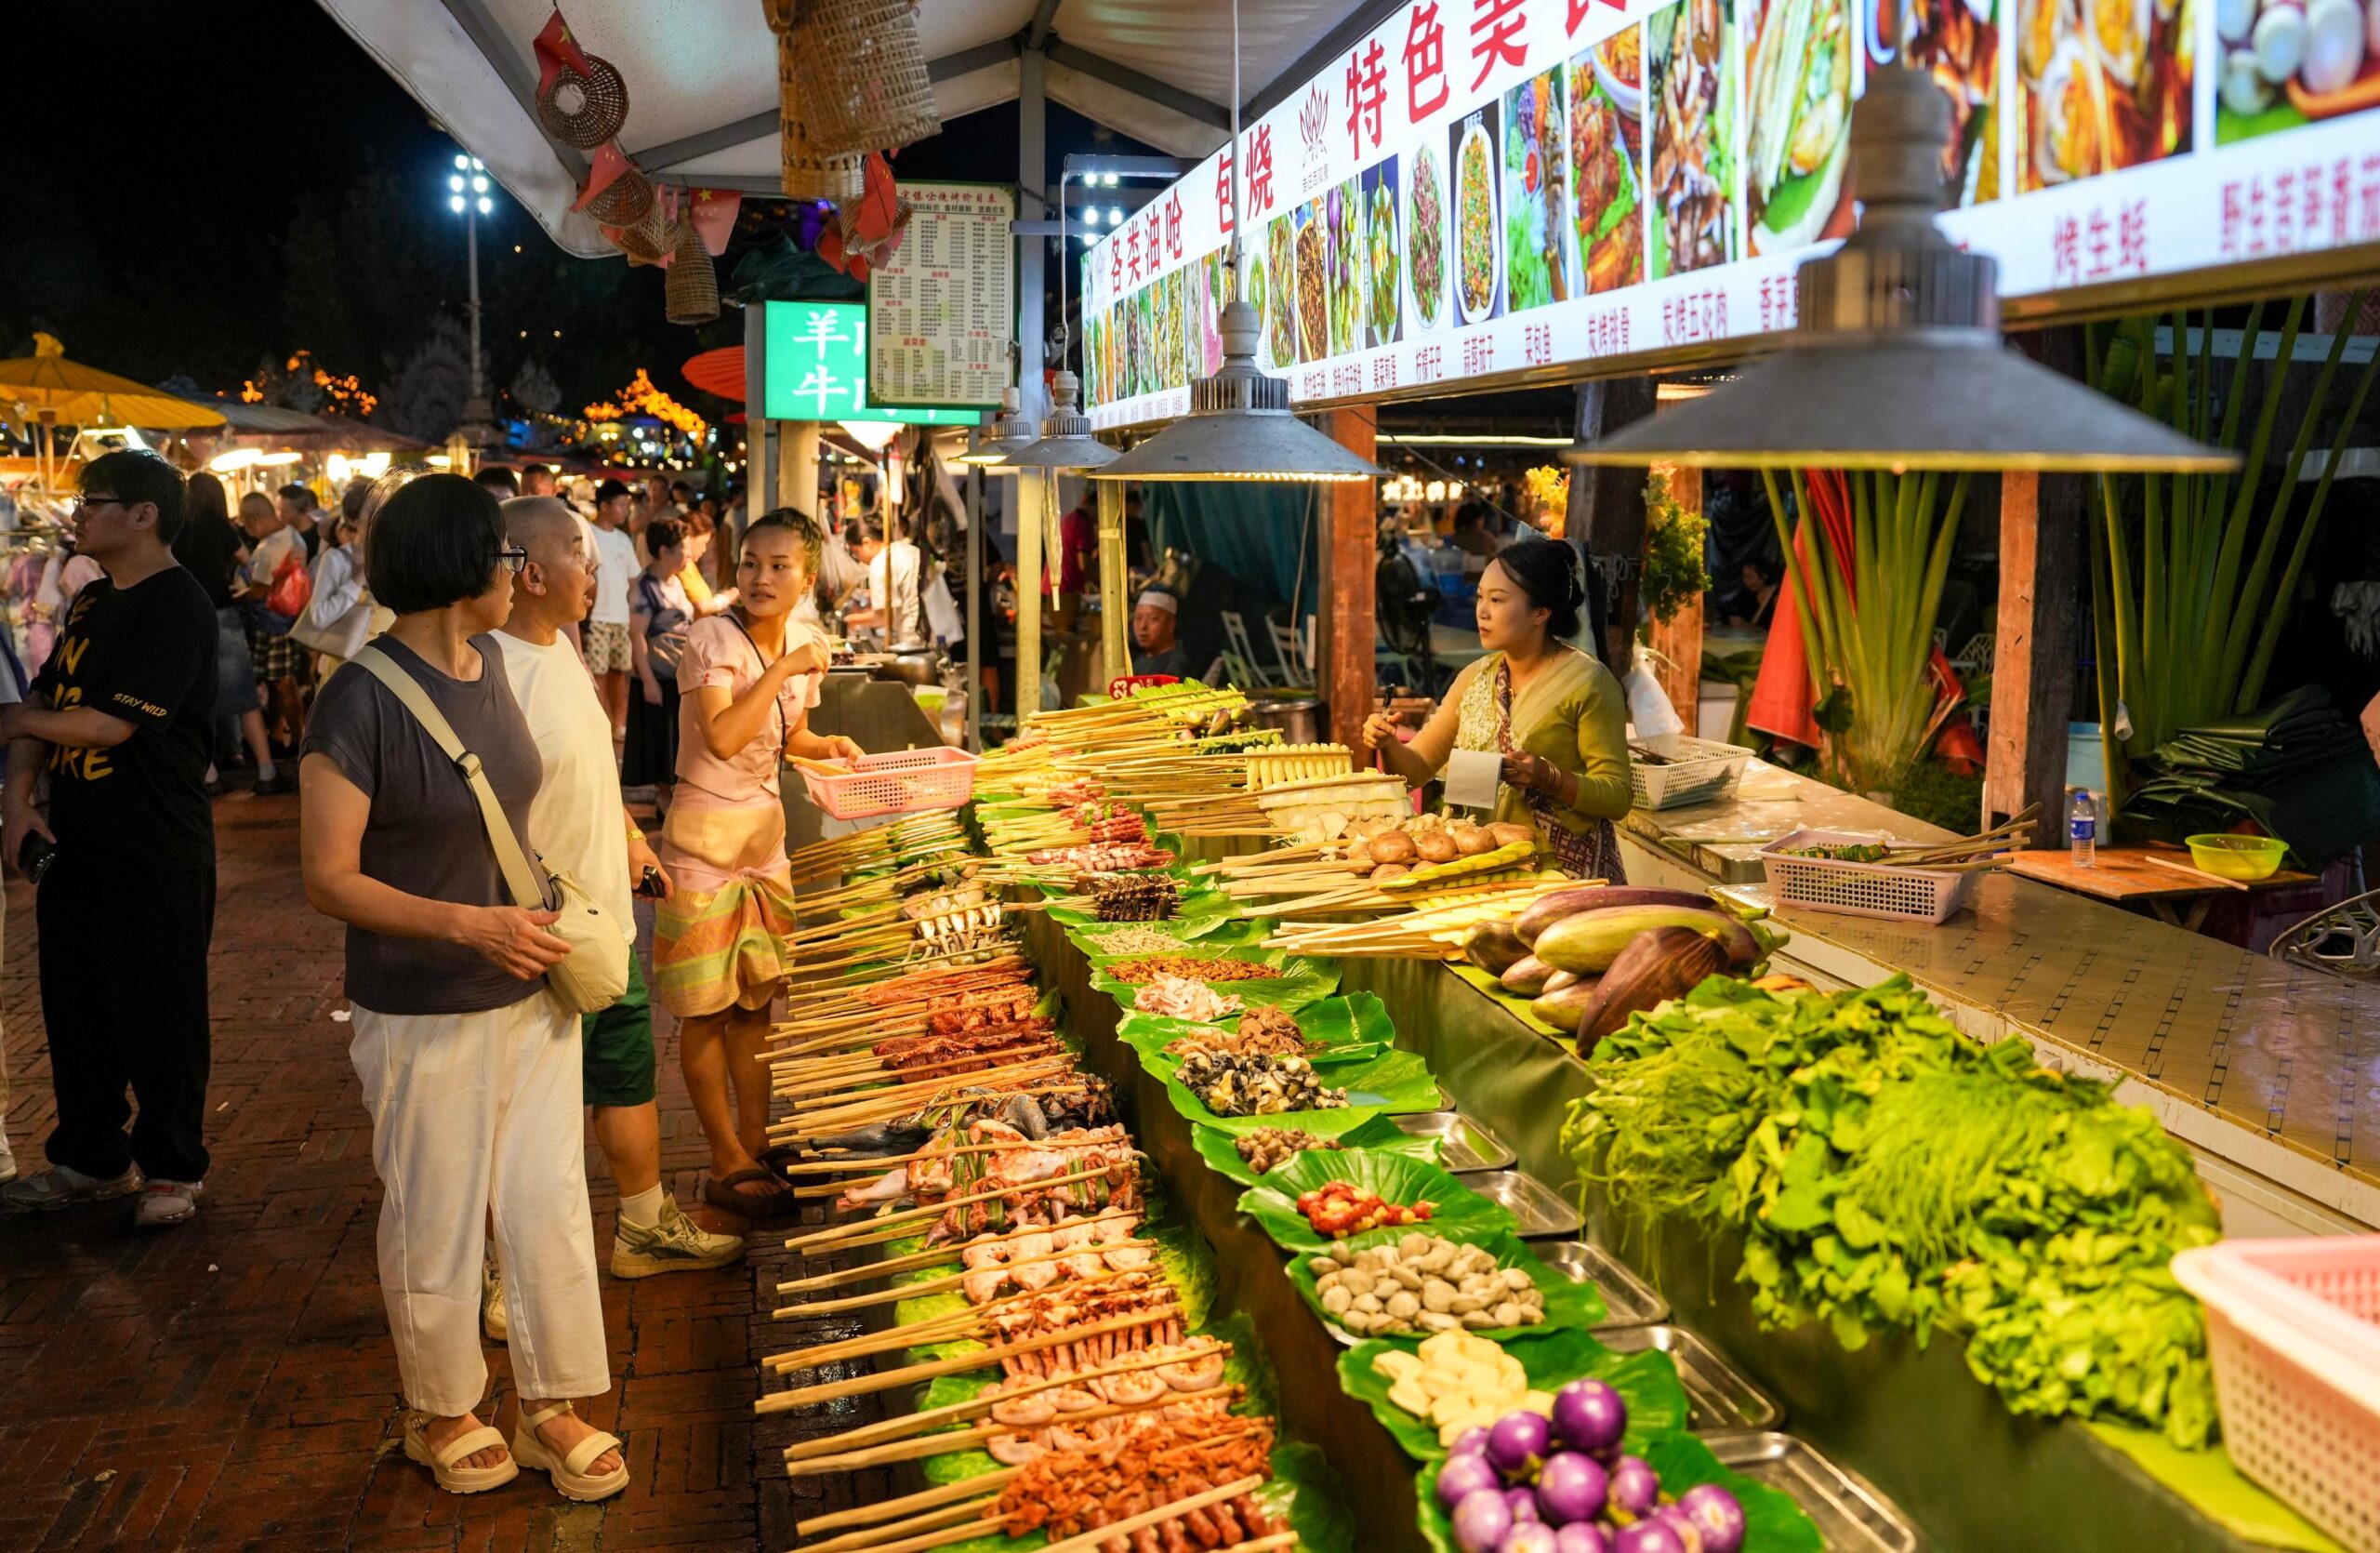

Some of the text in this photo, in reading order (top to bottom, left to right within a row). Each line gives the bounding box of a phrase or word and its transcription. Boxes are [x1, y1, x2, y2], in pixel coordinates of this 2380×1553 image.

[1111, 186, 1183, 296] 各类油呛
[1216, 124, 1274, 234] 包烧
[1588, 306, 1630, 357] 炭烤排骨
[1663, 285, 1726, 348] 炭烤五花肉
[112, 693, 167, 717] STAY WILD
[1114, 680, 1128, 699] 23
